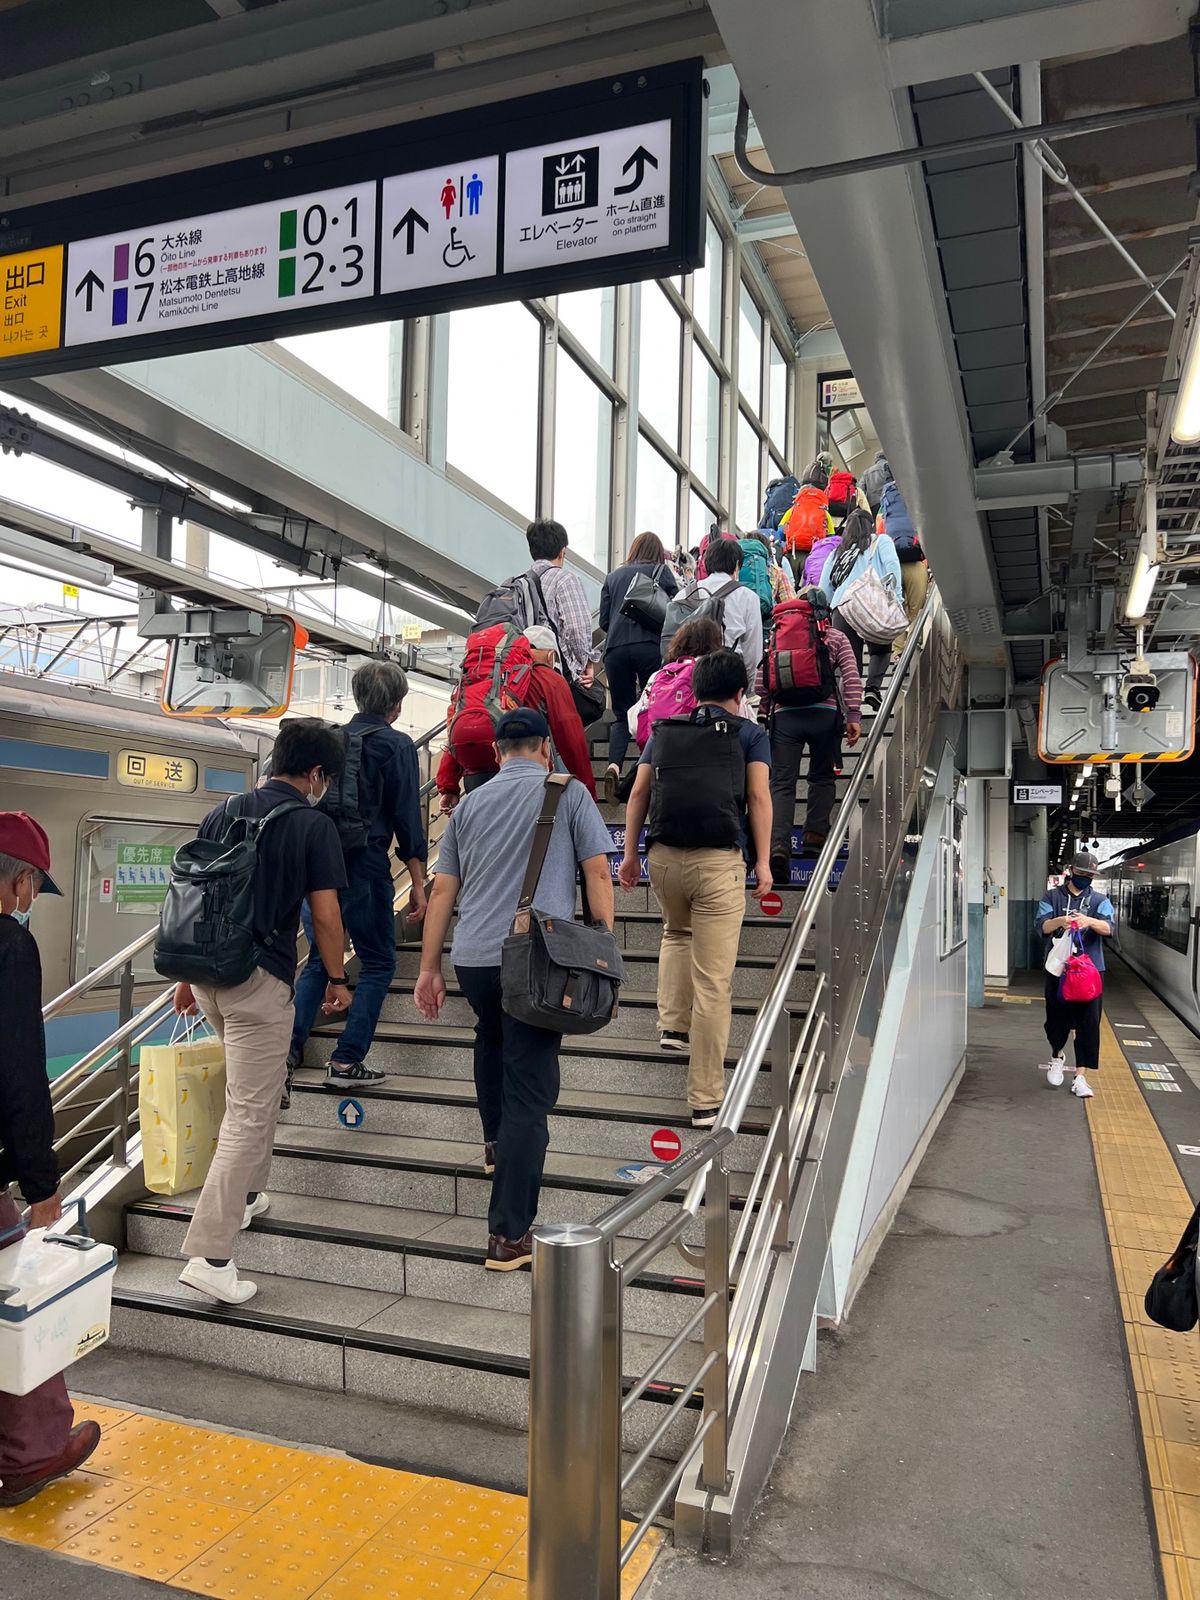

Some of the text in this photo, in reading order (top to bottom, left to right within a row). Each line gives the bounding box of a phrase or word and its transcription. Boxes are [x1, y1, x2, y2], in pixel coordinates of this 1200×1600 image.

[606, 194, 665, 217] ホーム直進
[613, 212, 657, 227] Go straight
[519, 216, 598, 242] エレベーター
[612, 223, 657, 236] on platform
[161, 229, 203, 251] 大糸線
[556, 236, 598, 250] Elevator
[134, 237, 156, 278] 6
[179, 249, 196, 259] Line
[6, 262, 45, 292] 出口
[160, 262, 265, 296] 松本電鉄上高地線
[4, 294, 27, 310] Exit
[134, 281, 155, 322] 7
[159, 287, 241, 307] Matsumoto Dentetsu
[201, 302, 218, 312] Line
[4, 312, 24, 326] 出口
[3, 325, 48, 343] 나가는 곳
[831, 383, 838, 392] 6
[831, 394, 837, 403] 7
[123, 846, 162, 863] 優先席
